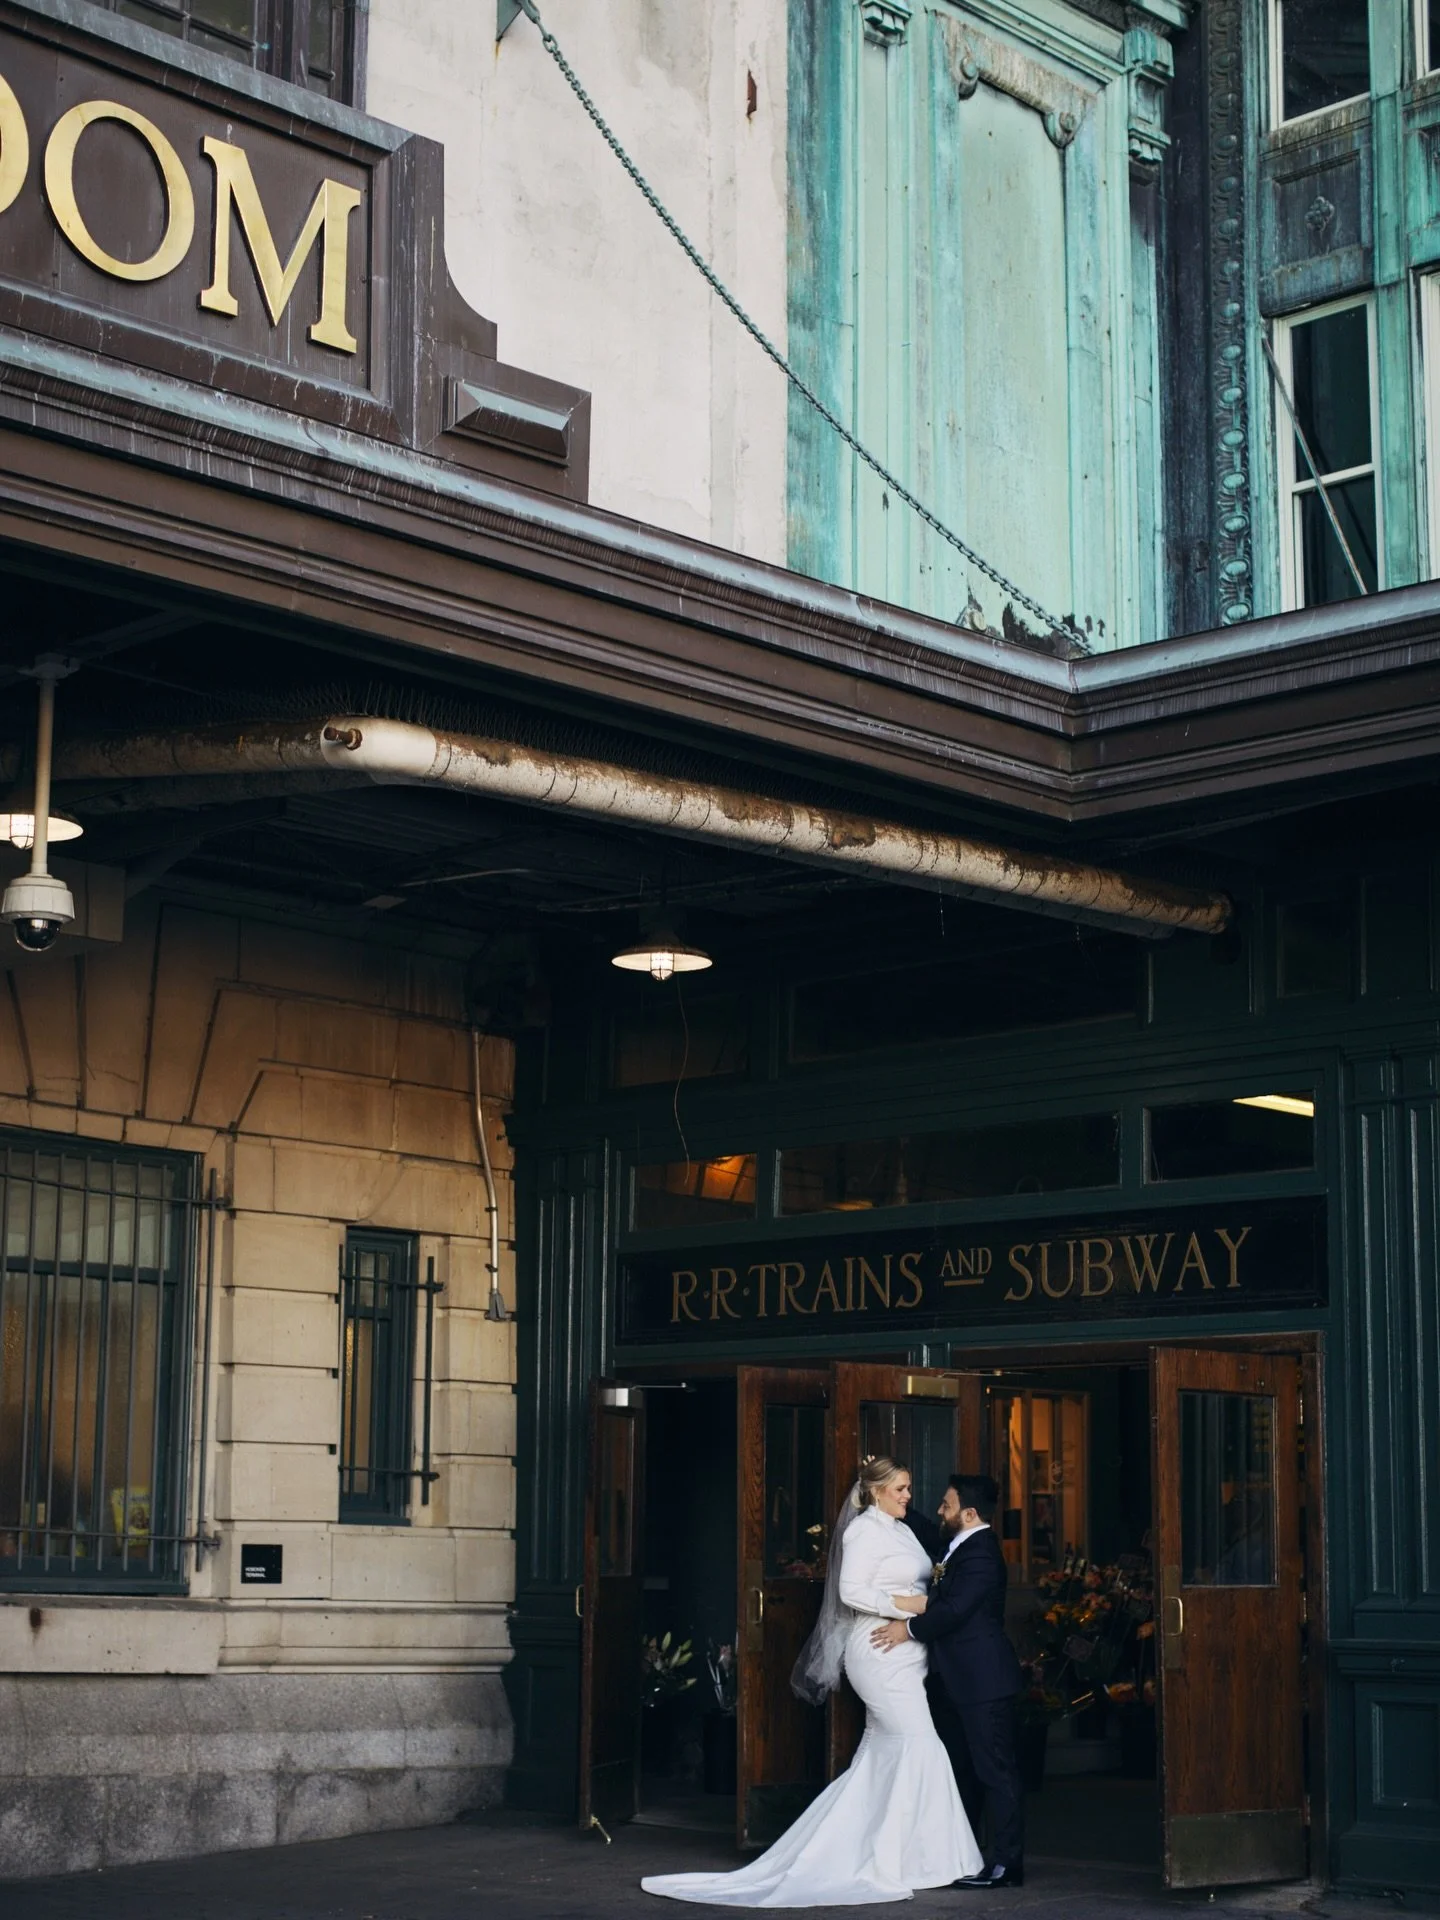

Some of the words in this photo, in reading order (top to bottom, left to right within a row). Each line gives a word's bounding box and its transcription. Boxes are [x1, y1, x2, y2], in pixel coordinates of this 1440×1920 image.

[0, 74, 361, 354] OM
[939, 1247, 993, 1277] AND
[1003, 1226, 1252, 1302] SUBWAY
